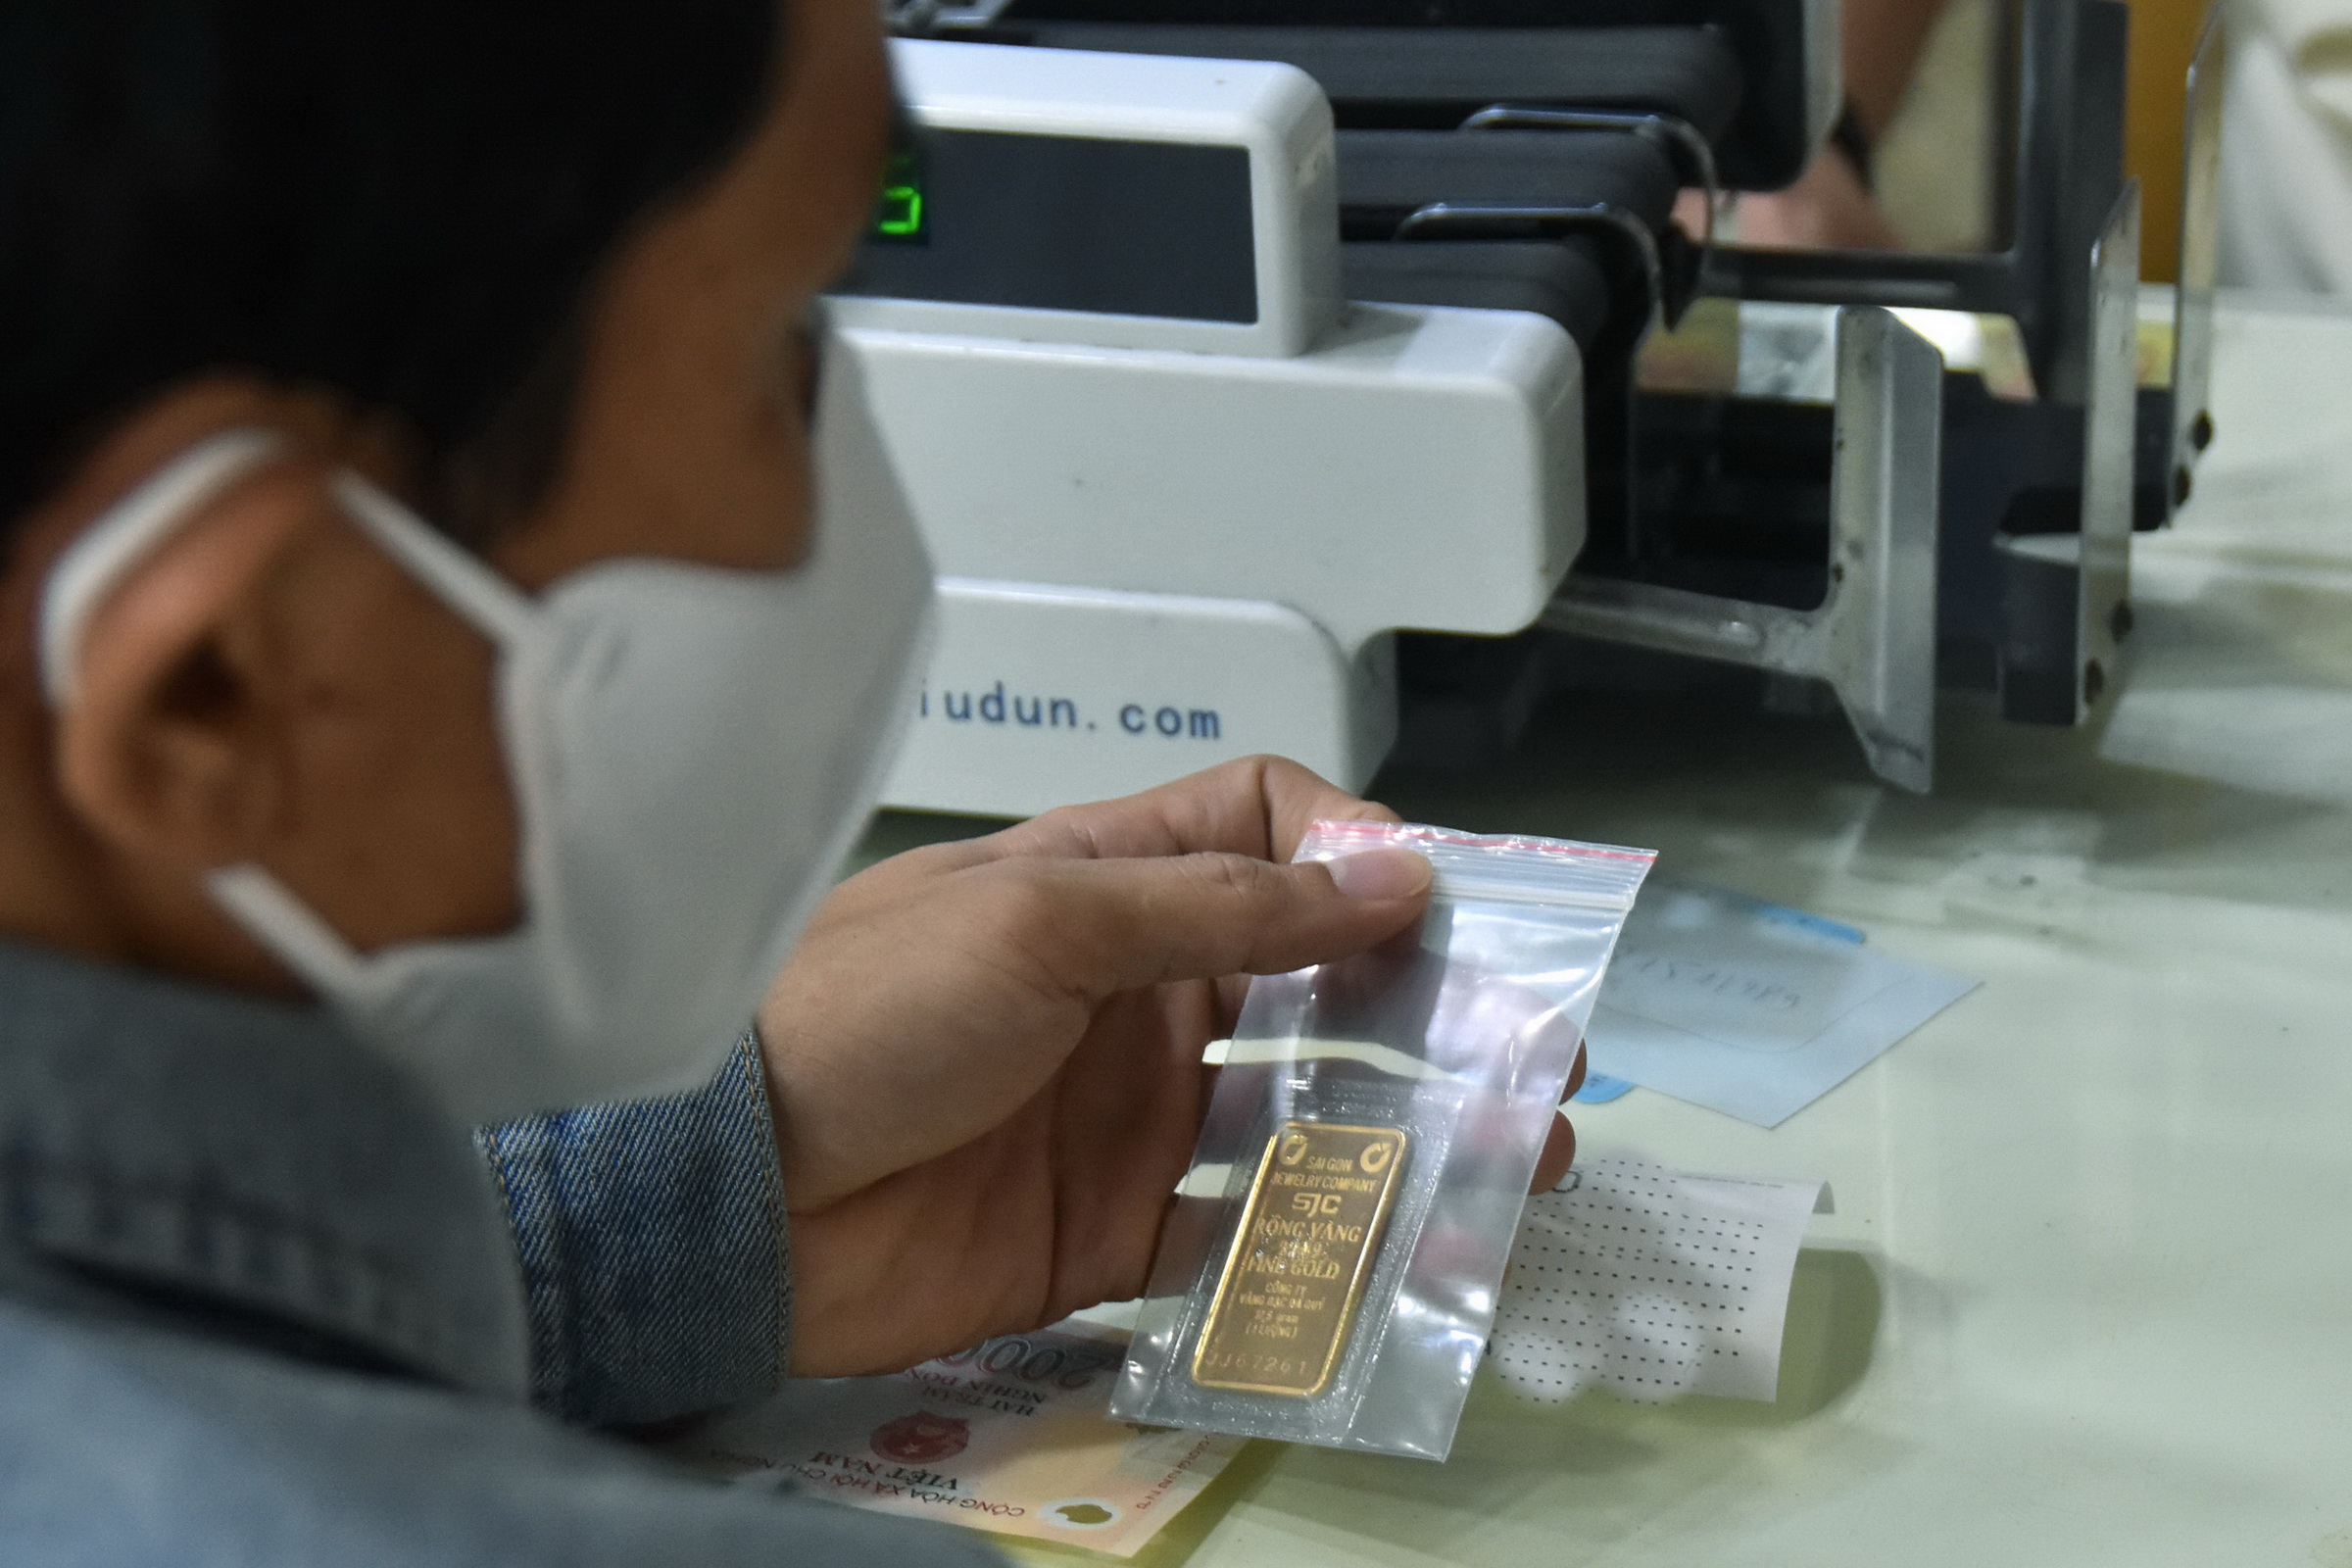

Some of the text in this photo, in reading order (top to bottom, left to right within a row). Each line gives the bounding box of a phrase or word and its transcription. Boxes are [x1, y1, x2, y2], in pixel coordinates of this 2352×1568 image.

[919, 677, 1222, 740] iudun.com
[1321, 1175, 1378, 1193] COMPANY
[1292, 1193, 1342, 1217] SJC
[1308, 1221, 1362, 1243] VÀNG
[1288, 1257, 1341, 1280] GOLD
[808, 1451, 958, 1491] VIỆT NAM
[959, 1497, 1025, 1518] CỘNG
